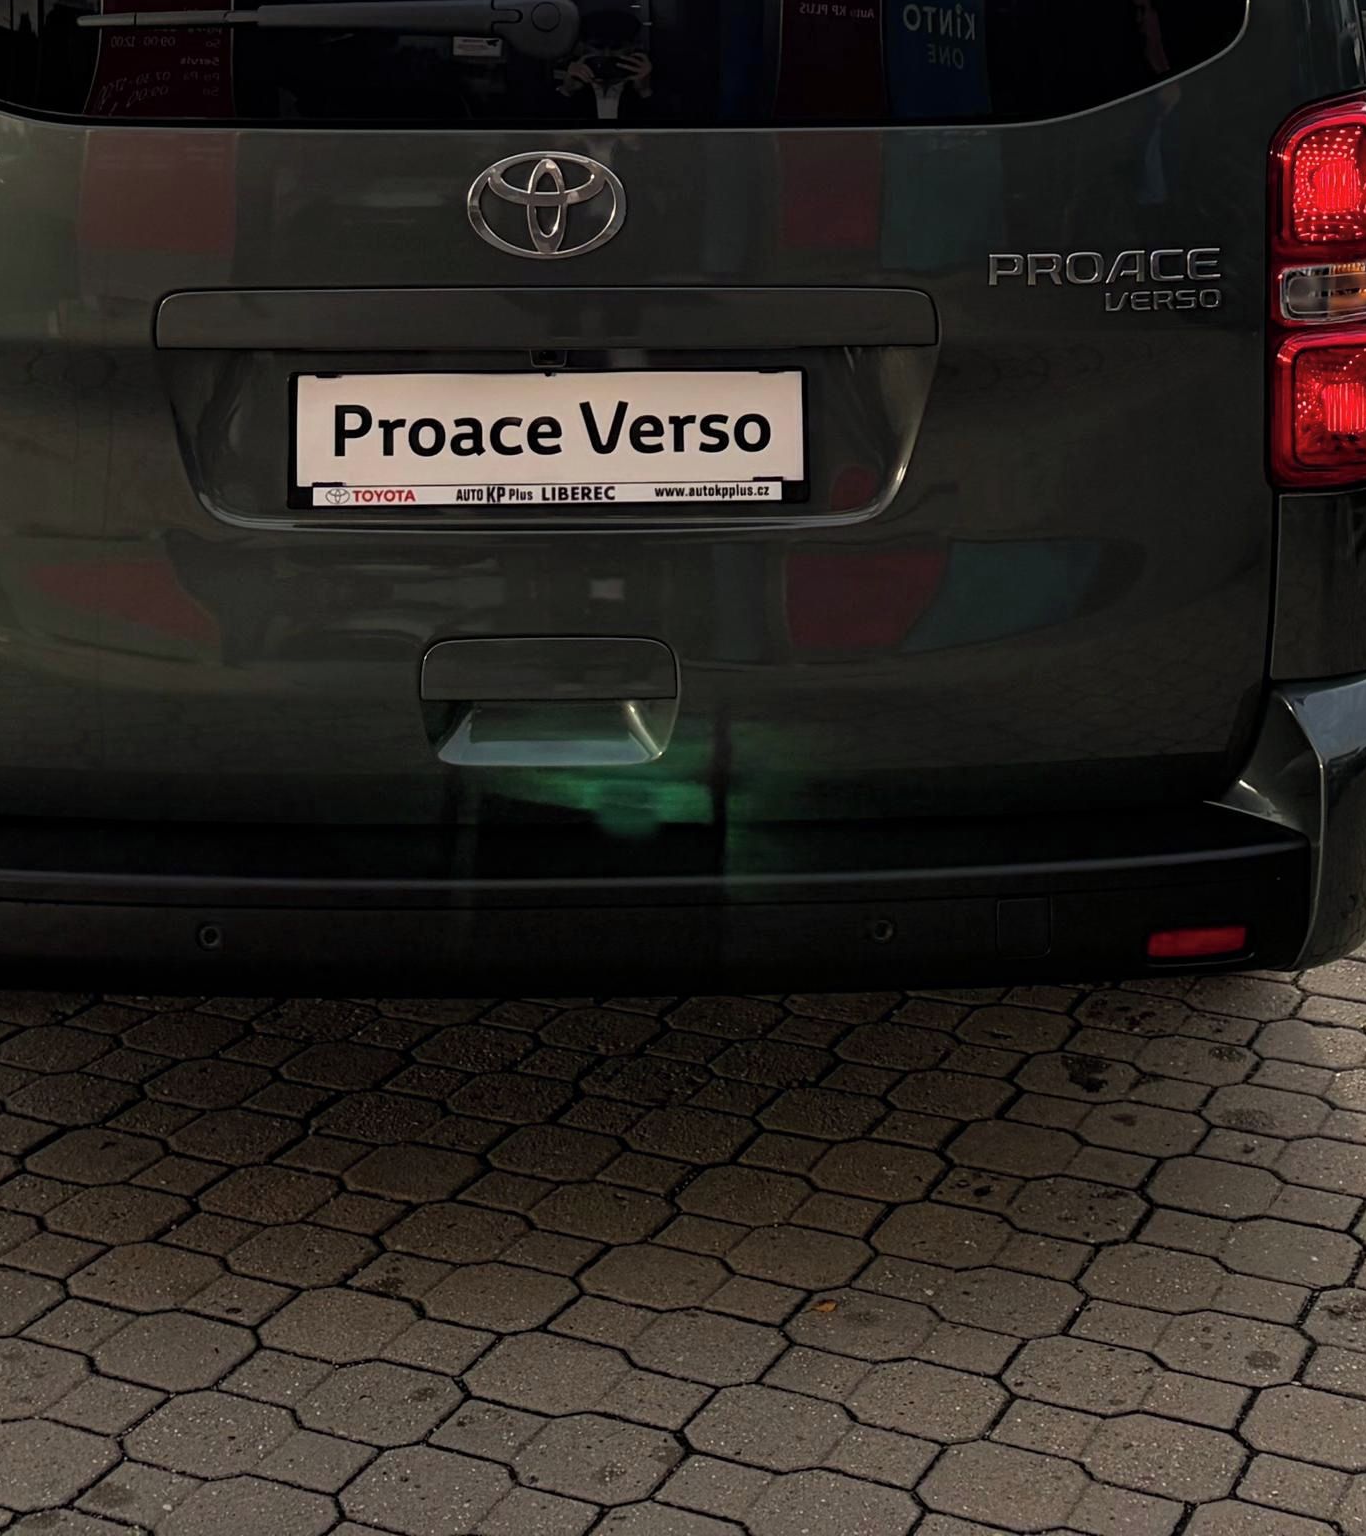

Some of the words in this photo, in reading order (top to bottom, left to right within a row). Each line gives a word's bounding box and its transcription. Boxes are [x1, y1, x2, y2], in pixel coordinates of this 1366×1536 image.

[988, 248, 1221, 286] PROACE
[1104, 289, 1222, 312] VERSO
[333, 404, 563, 457] Proace
[579, 400, 773, 455] Verso
[352, 489, 417, 503] TOYOTA
[456, 488, 483, 502] AUTO
[486, 486, 506, 503] KP
[508, 489, 534, 501] Plus
[541, 486, 616, 501] LIBEREC
[654, 484, 771, 499] www.autokpplus.cz
